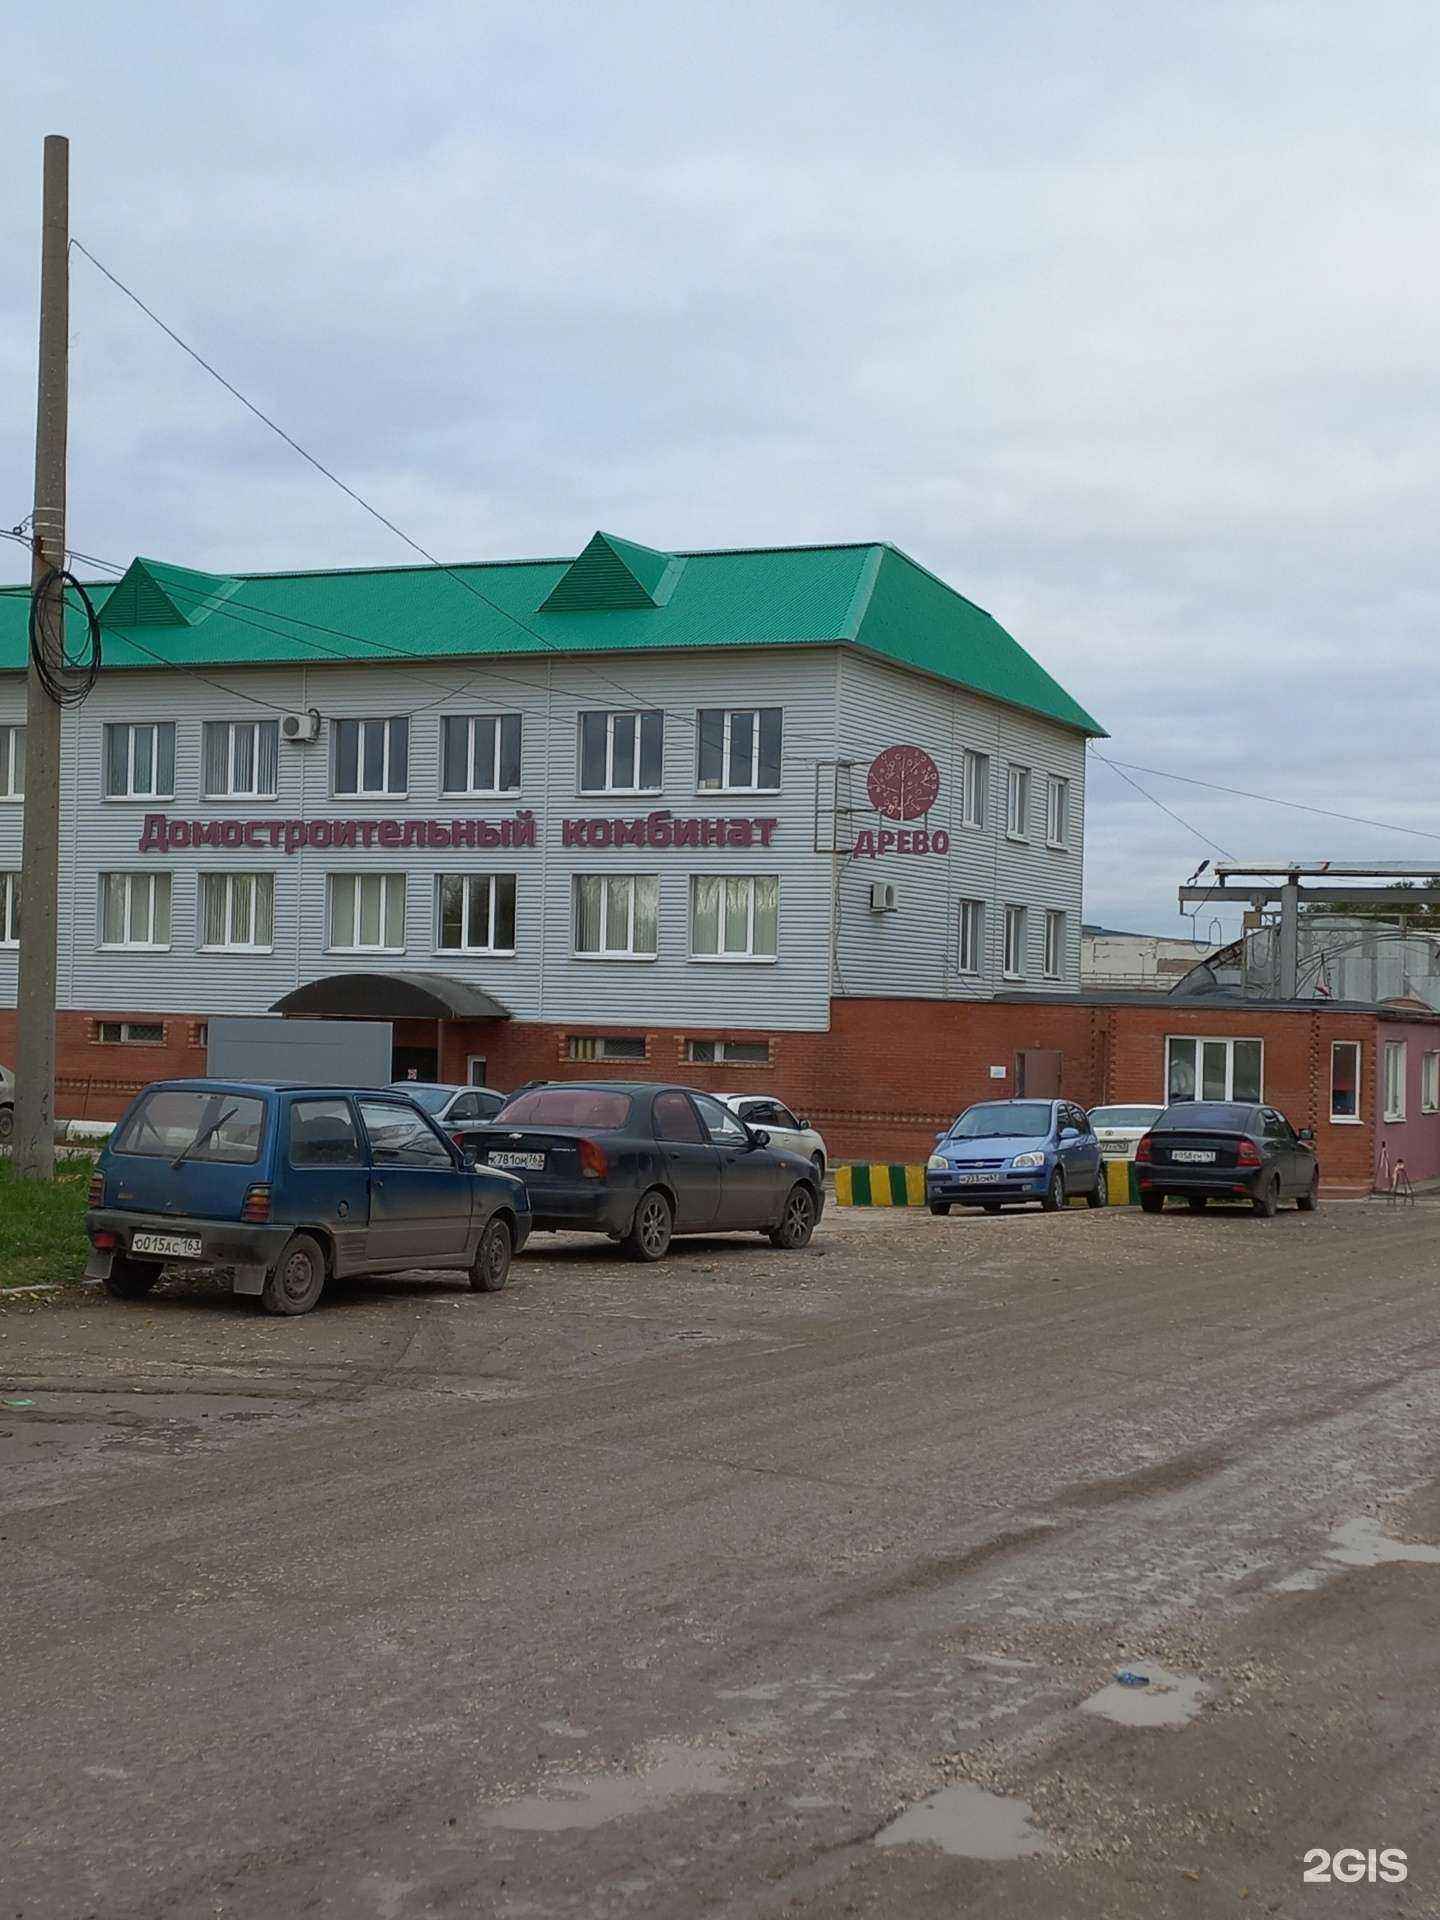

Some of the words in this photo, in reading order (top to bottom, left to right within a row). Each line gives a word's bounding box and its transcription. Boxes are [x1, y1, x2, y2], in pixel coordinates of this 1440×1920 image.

[139, 810, 536, 855] Домостроительный
[561, 810, 778, 848] комбинат
[853, 829, 949, 859] ДРЕВО
